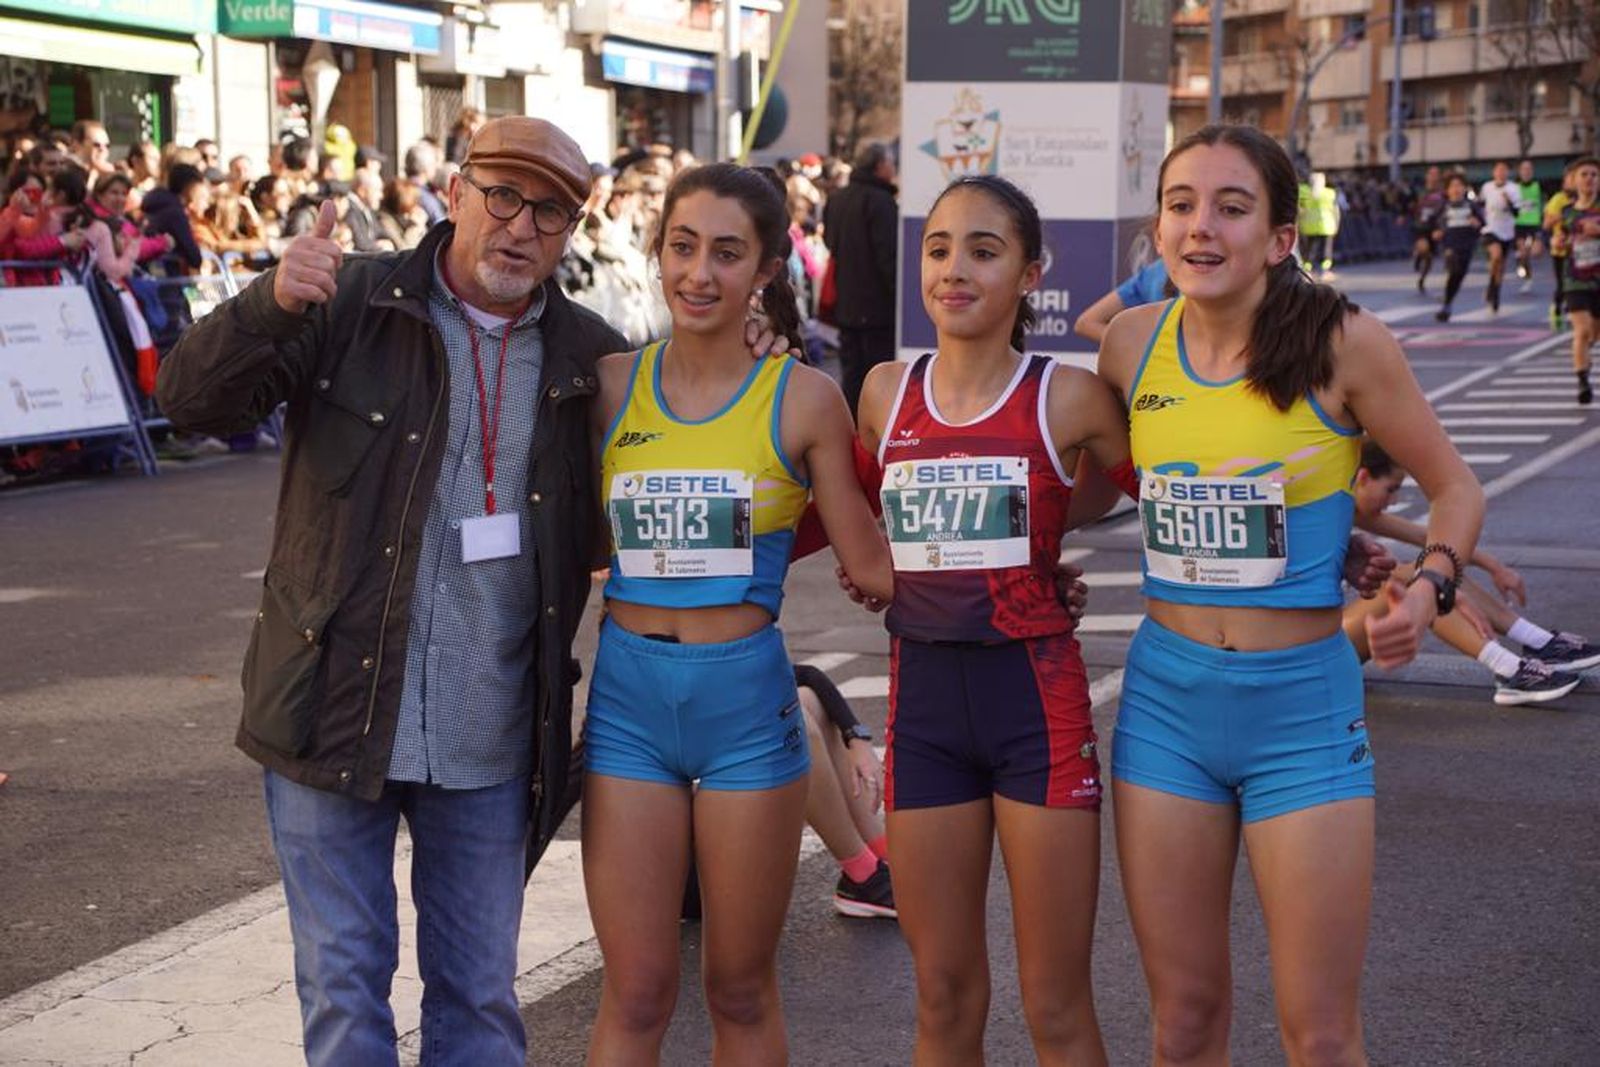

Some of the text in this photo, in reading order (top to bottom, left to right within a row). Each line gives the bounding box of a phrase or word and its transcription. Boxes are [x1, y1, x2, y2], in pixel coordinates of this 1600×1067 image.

[225, 0, 289, 21] Verde
[917, 463, 1013, 484] SETEL
[646, 476, 738, 494] SETEL
[1170, 483, 1268, 500] SETEL
[633, 499, 709, 540] 5513
[900, 487, 989, 533] 5477
[926, 531, 964, 541] ANDREA
[1155, 502, 1247, 549] 5606
